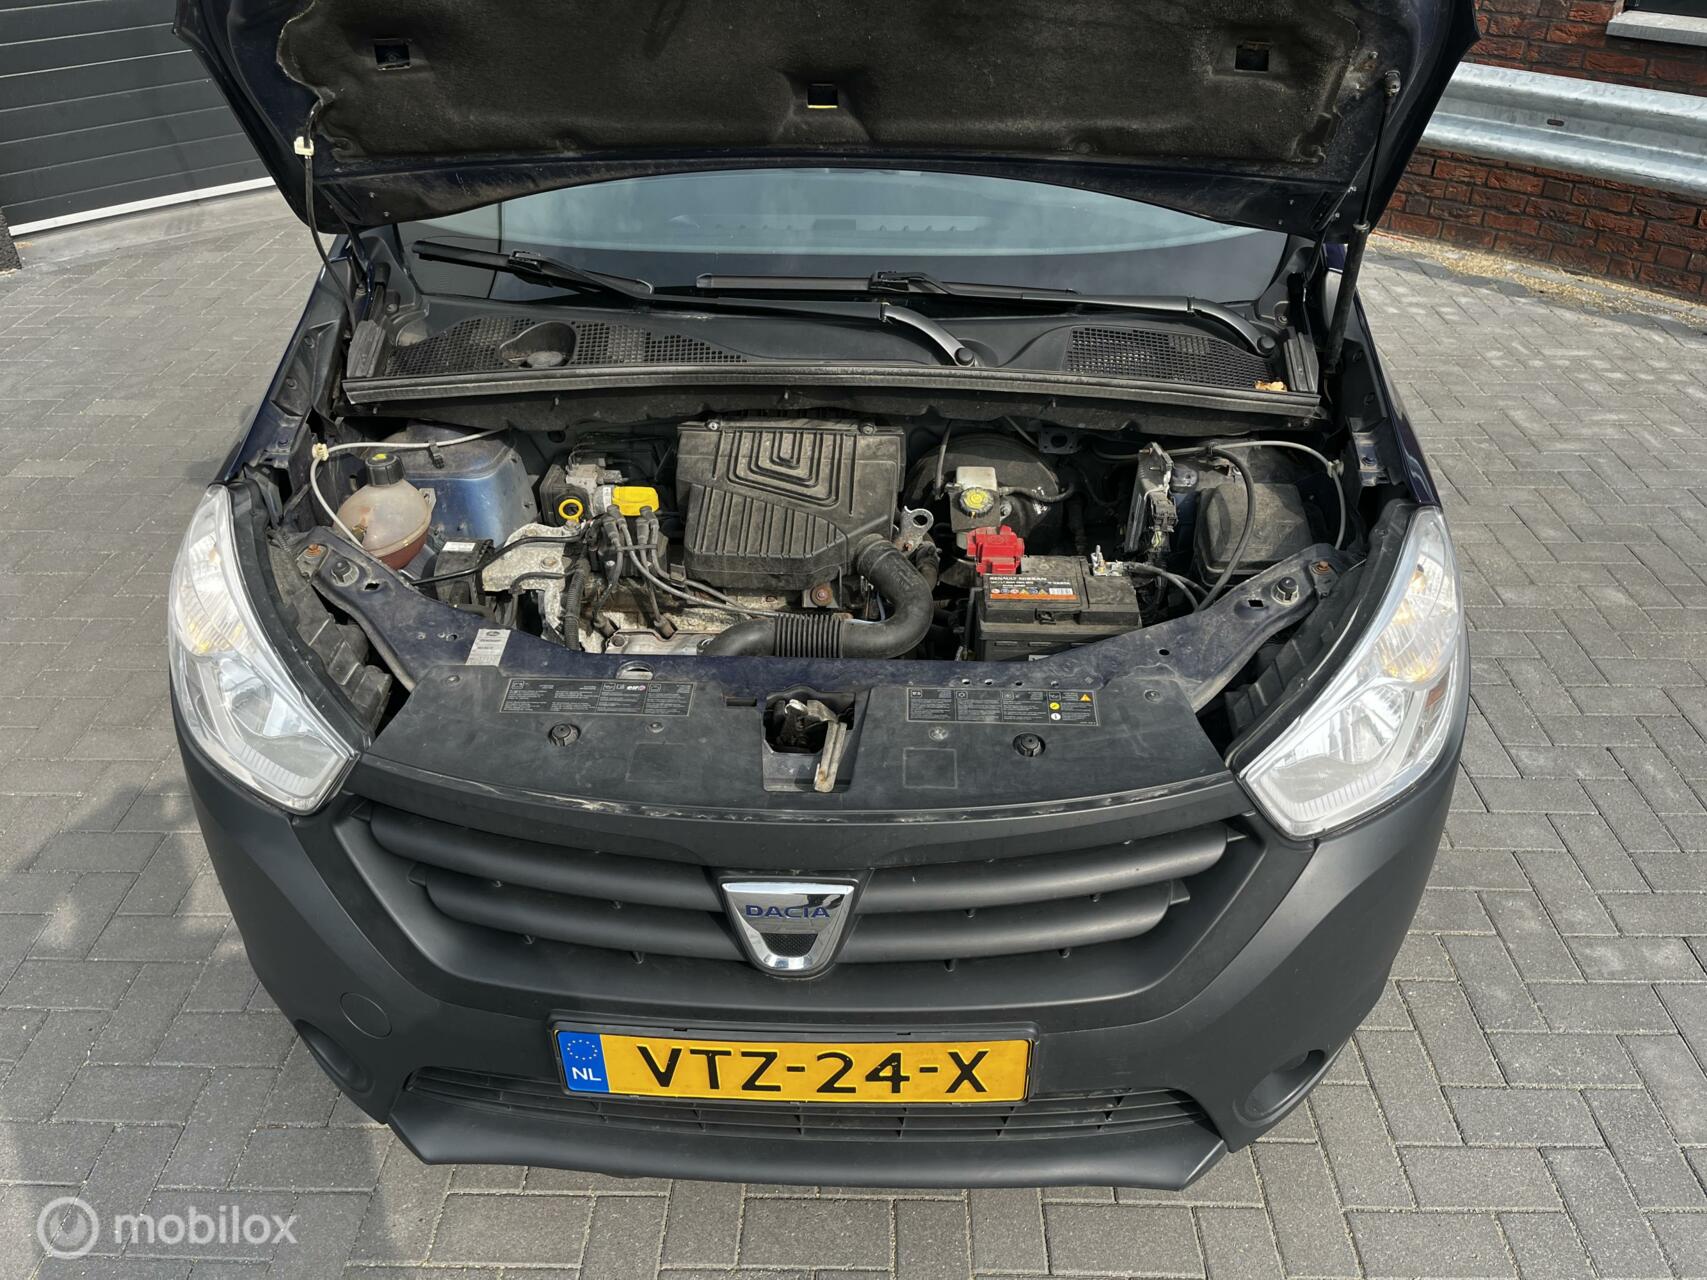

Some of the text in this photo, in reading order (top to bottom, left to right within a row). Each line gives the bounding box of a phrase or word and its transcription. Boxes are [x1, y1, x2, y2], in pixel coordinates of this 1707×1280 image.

[745, 904, 830, 918] DACIA
[572, 1066, 602, 1082] NL
[636, 1044, 990, 1095] VTZ-24-X
